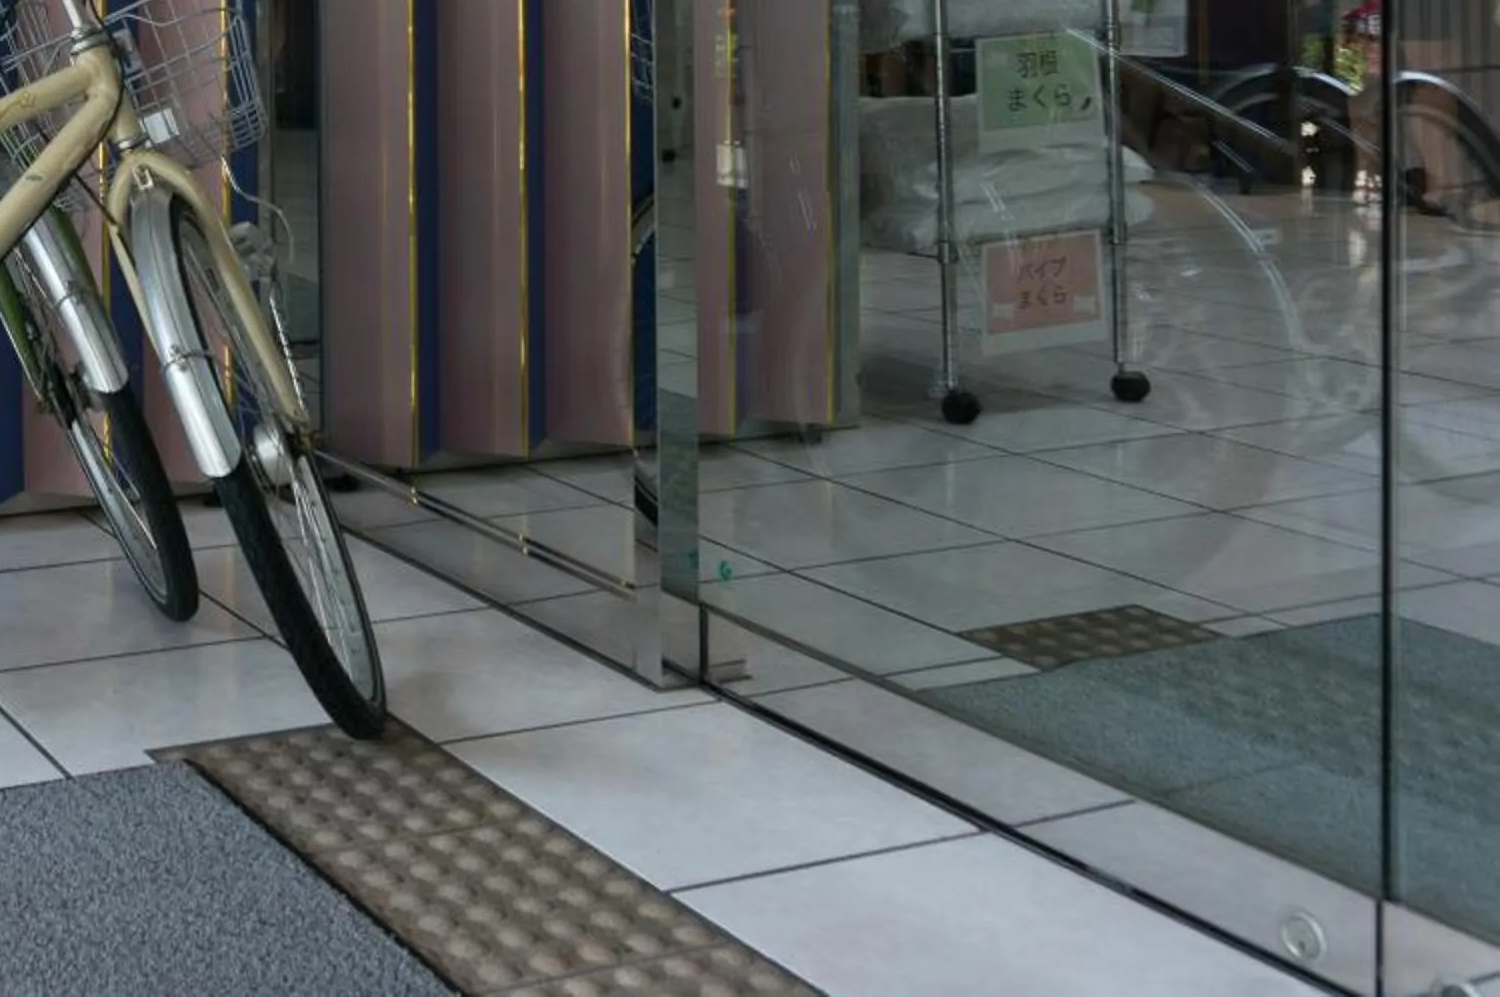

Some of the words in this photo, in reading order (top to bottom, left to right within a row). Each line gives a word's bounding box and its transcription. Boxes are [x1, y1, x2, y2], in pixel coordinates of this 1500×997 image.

[1007, 83, 1072, 112] まくら
[1018, 284, 1067, 310] まくら
